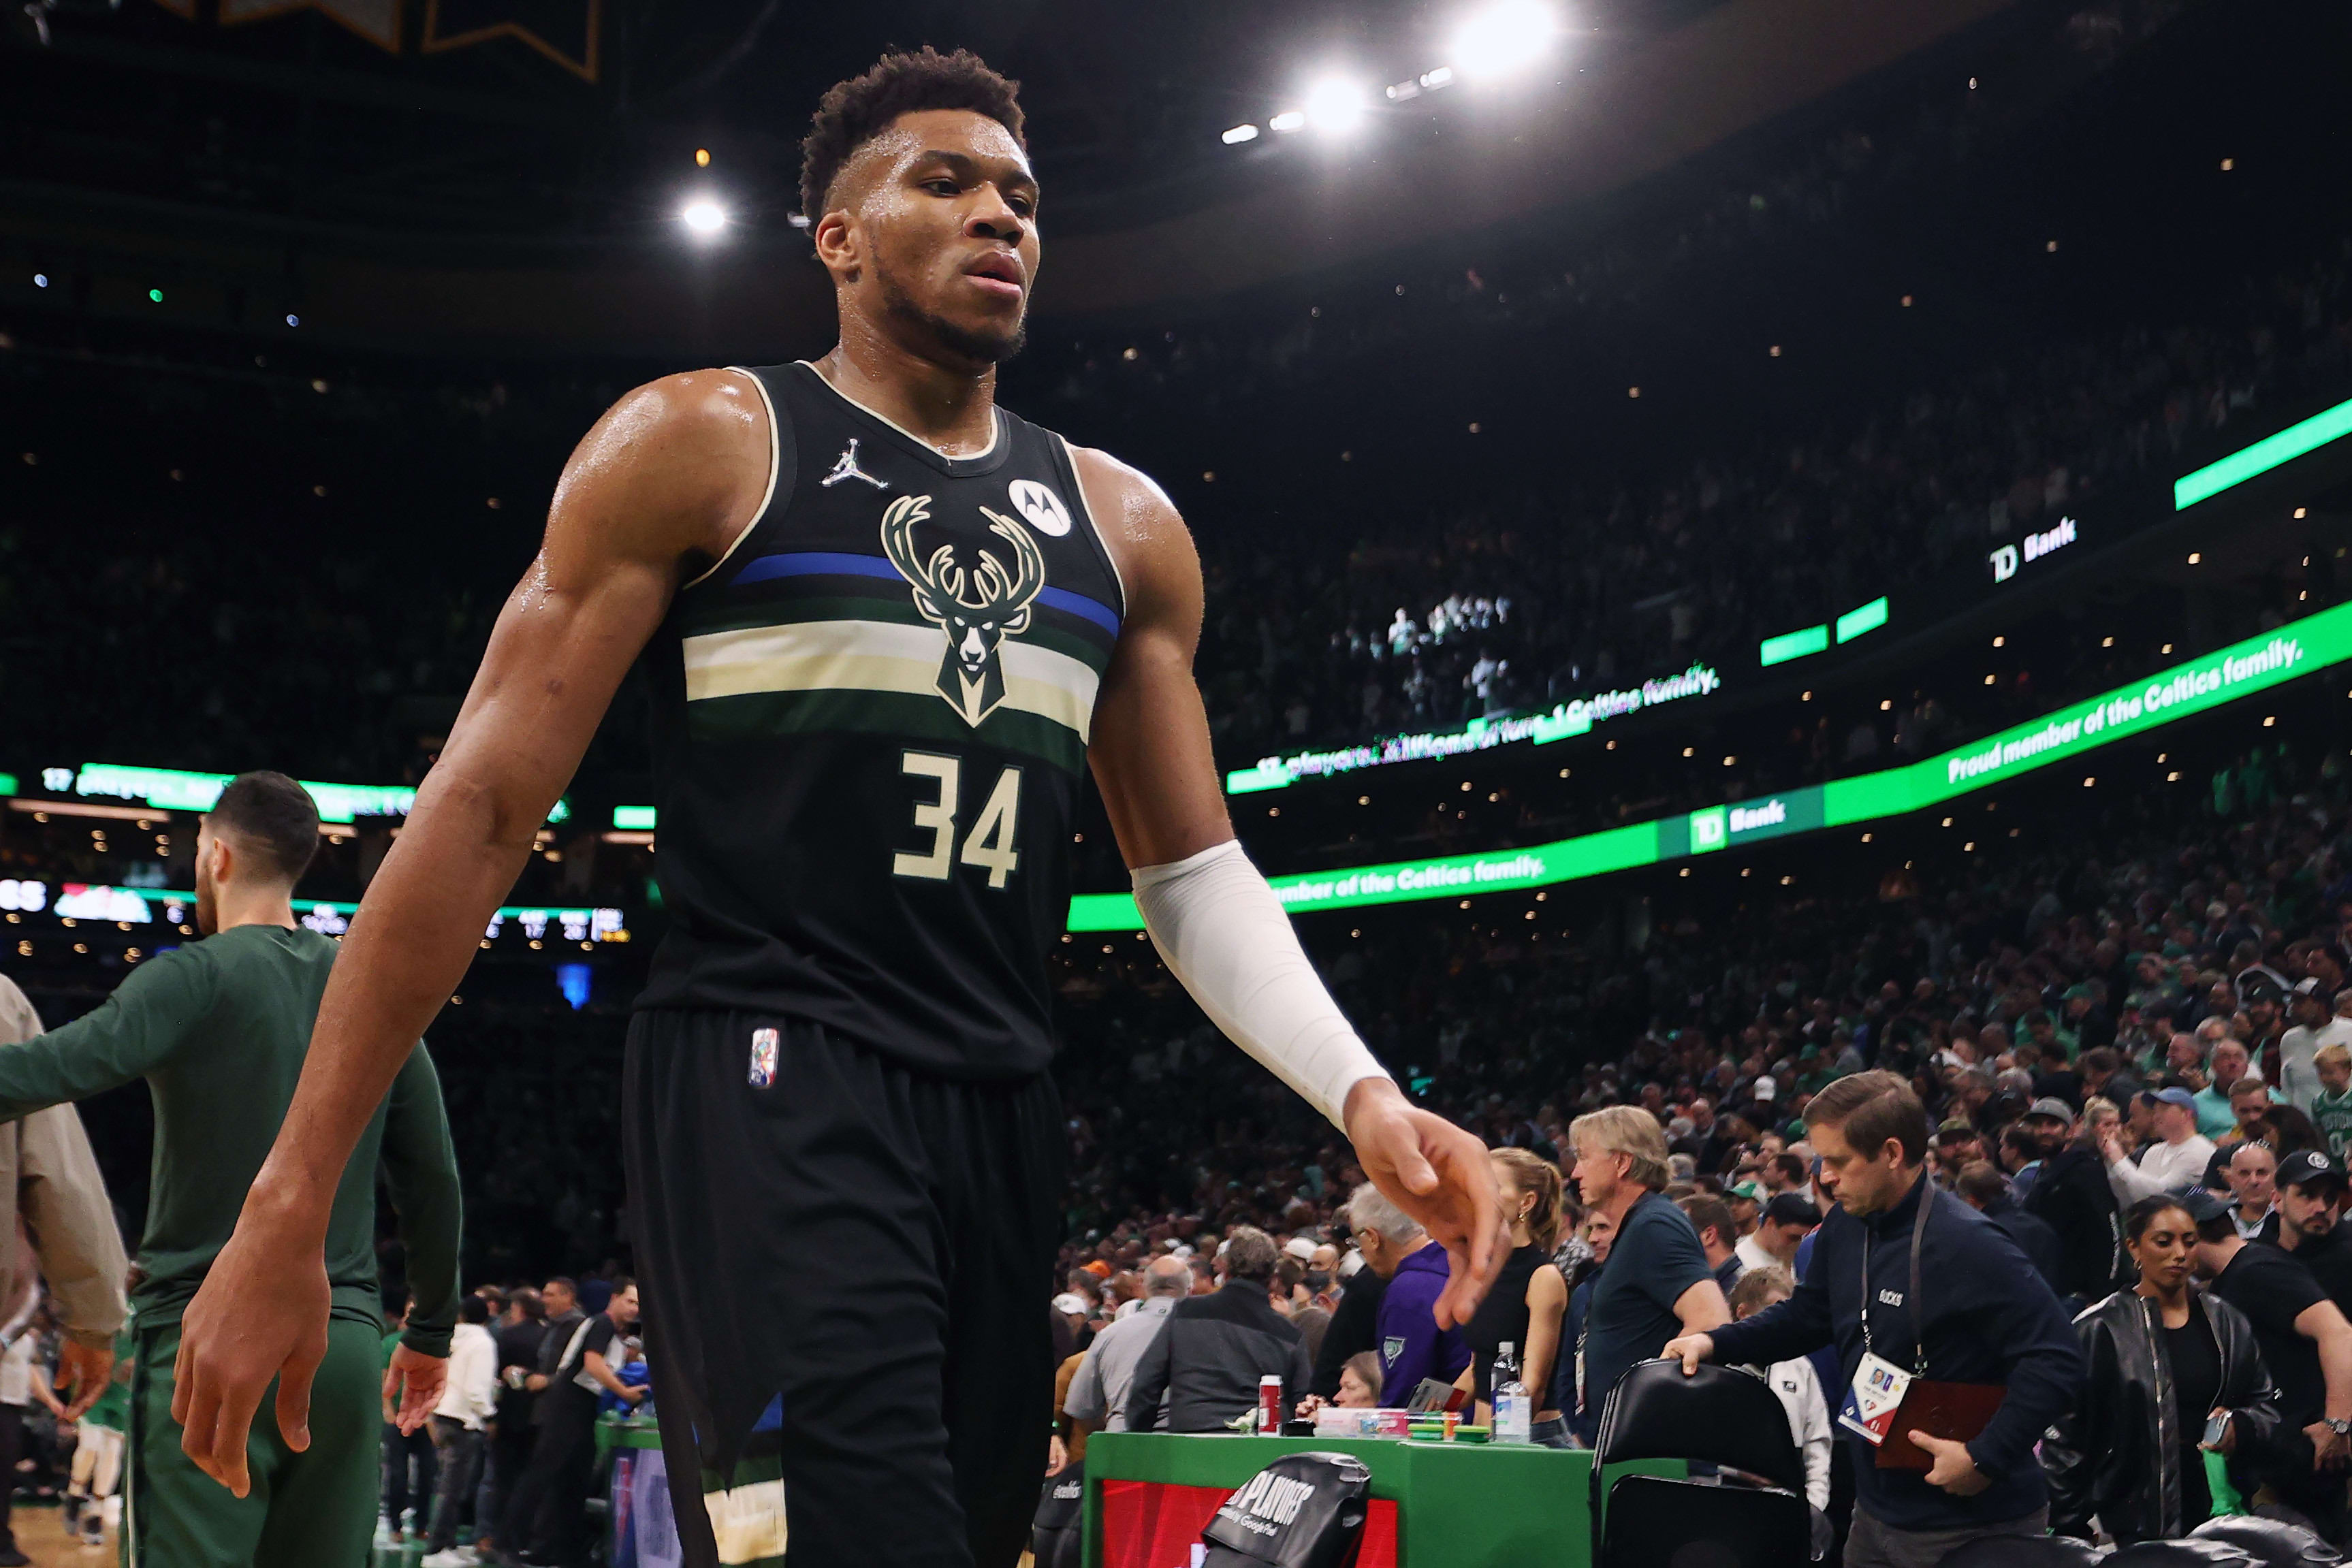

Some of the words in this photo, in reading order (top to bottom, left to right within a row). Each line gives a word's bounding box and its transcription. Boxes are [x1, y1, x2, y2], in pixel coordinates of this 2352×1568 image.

[1989, 544, 2020, 583] TD
[2023, 515, 2078, 563] Bank
[1948, 741, 2002, 784] Proud
[2003, 718, 2082, 765] member
[2084, 703, 2105, 735] of
[2107, 697, 2143, 726] the
[2144, 667, 2222, 713] Celtics
[2223, 637, 2304, 686] family.
[893, 752, 1021, 889] 34
[1692, 814, 1725, 845] TD
[1729, 799, 1787, 833] Bank
[1335, 874, 1360, 898] of
[1361, 871, 1396, 894] the
[1397, 865, 1473, 891] Celtics
[1473, 853, 1546, 883] family.
[1878, 1287, 1905, 1308] BUCKS
[1237, 1469, 1316, 1526] PLAYOFFS
[1240, 1514, 1265, 1534] Google
